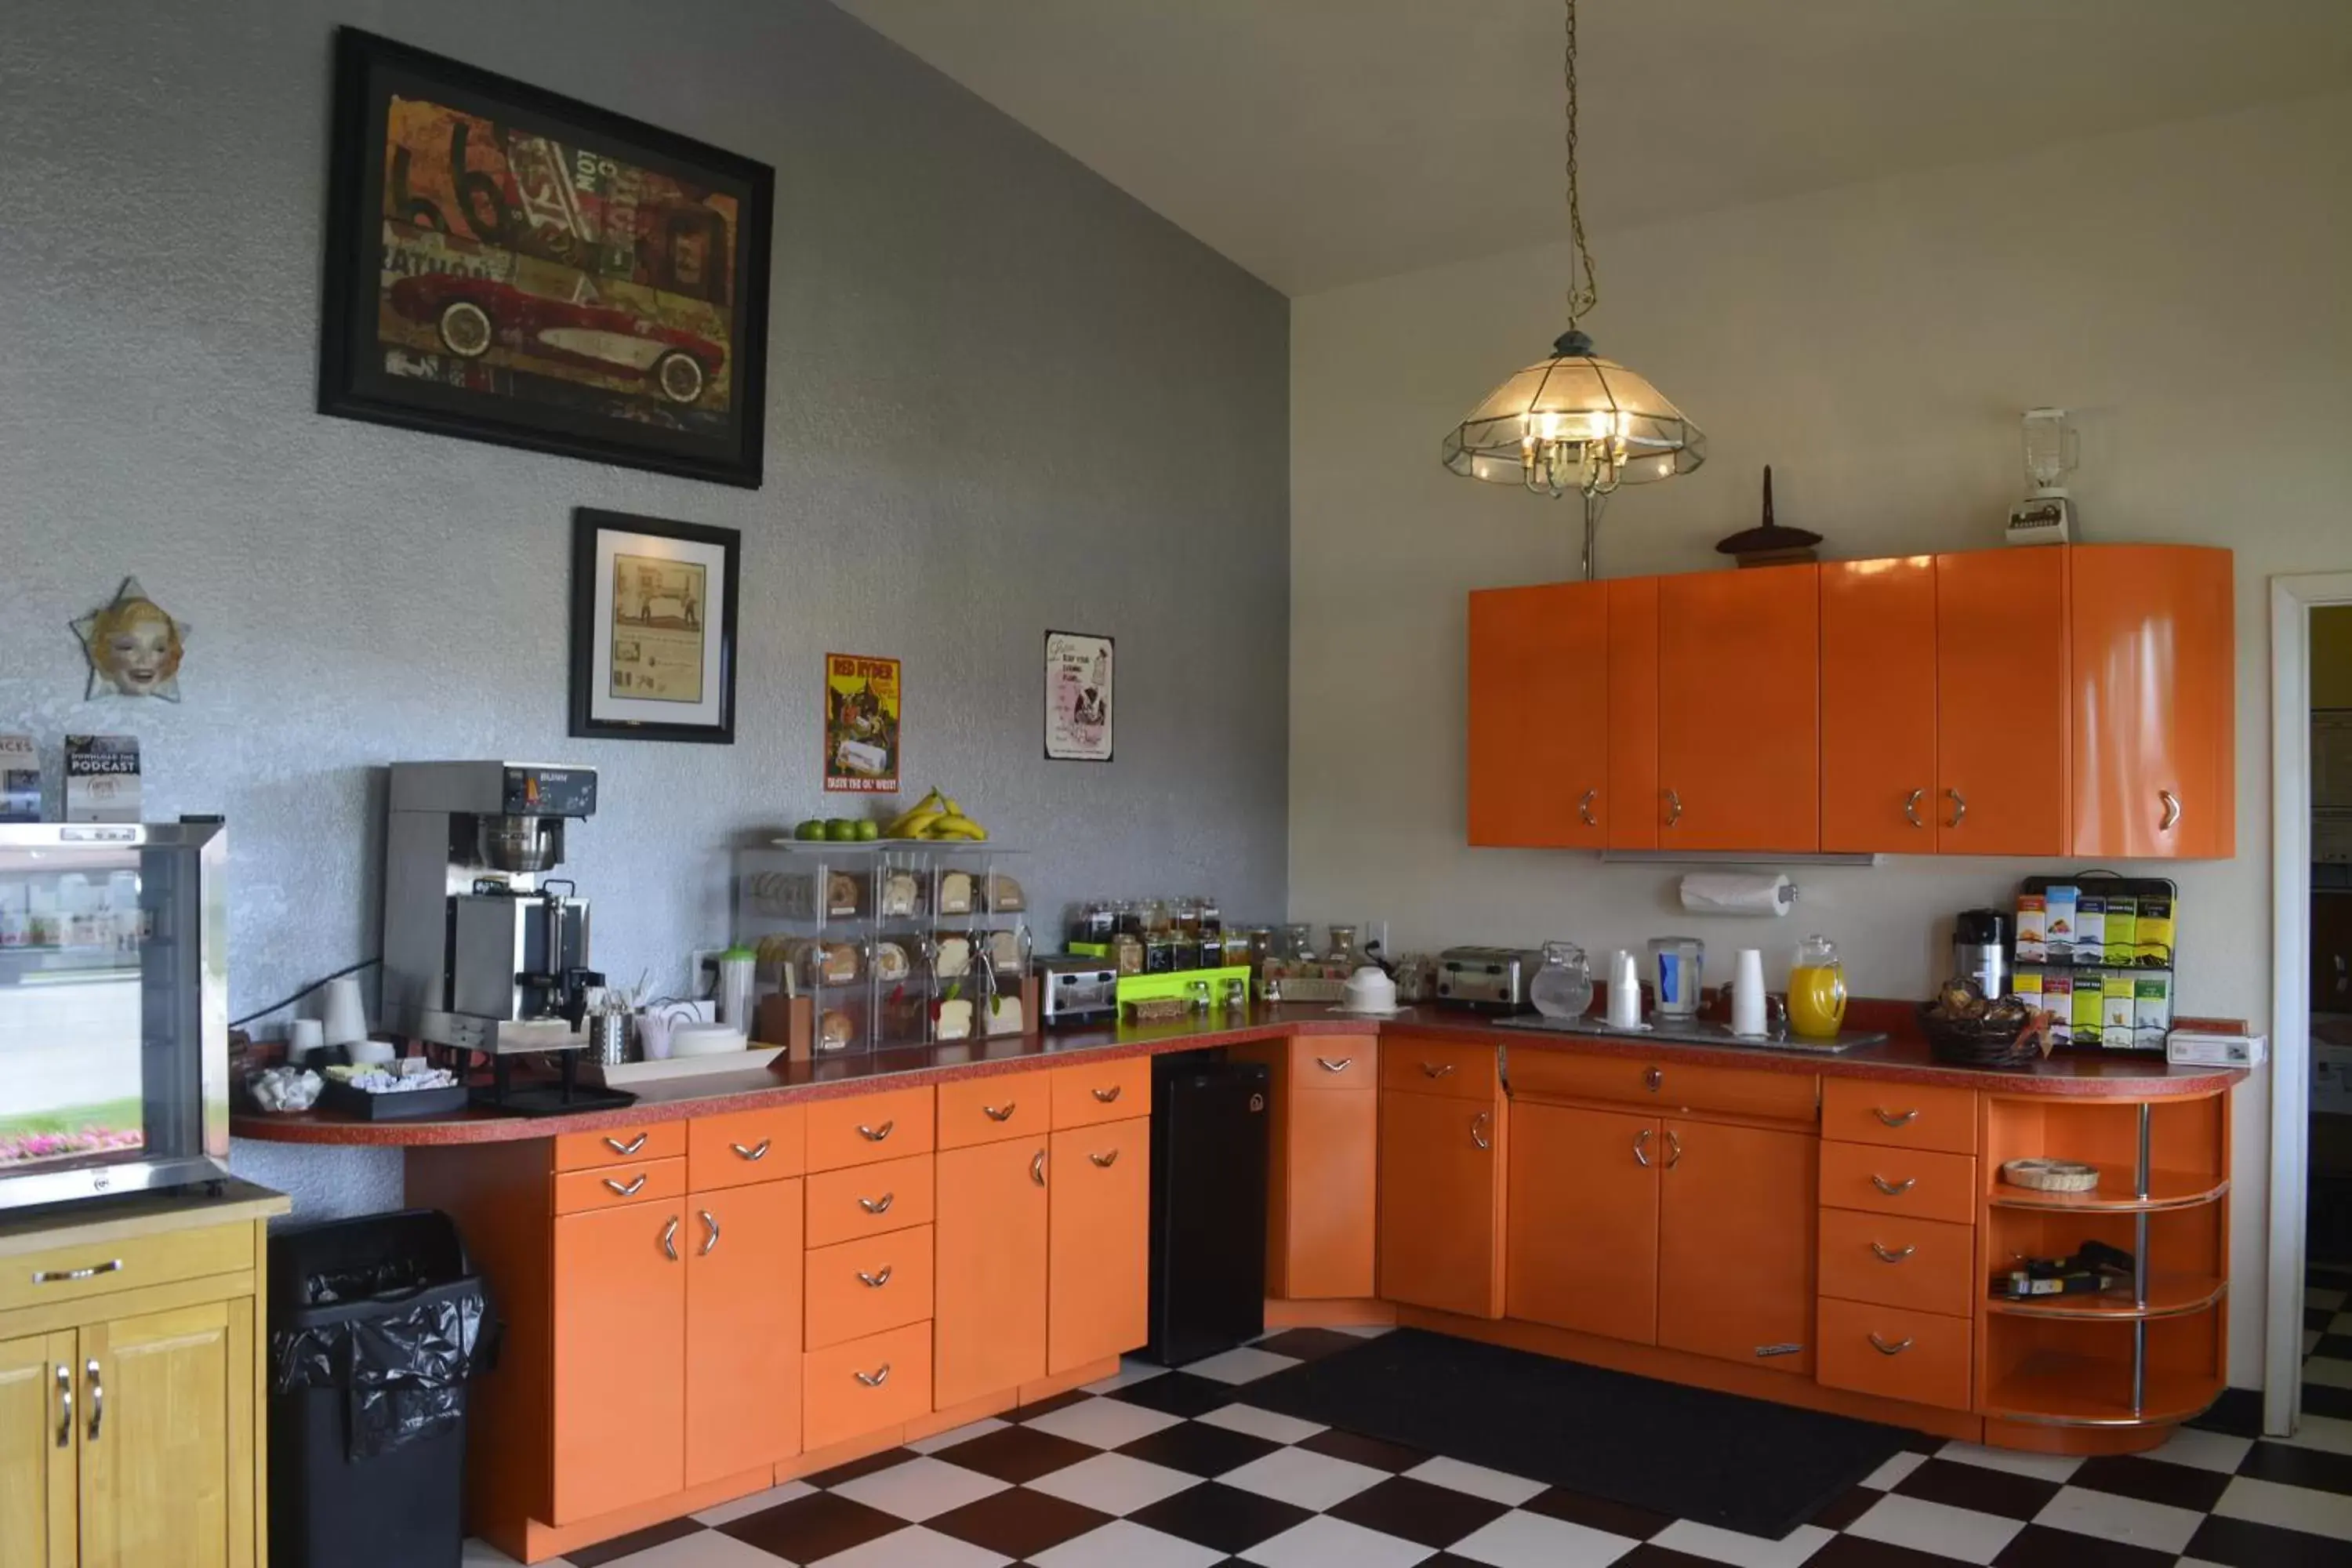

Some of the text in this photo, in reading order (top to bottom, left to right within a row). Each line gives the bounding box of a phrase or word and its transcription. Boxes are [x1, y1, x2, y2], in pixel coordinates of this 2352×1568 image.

[833, 659, 894, 680] RED RYDER
[71, 760, 135, 771] PODCAST
[540, 771, 568, 782] BUNN
